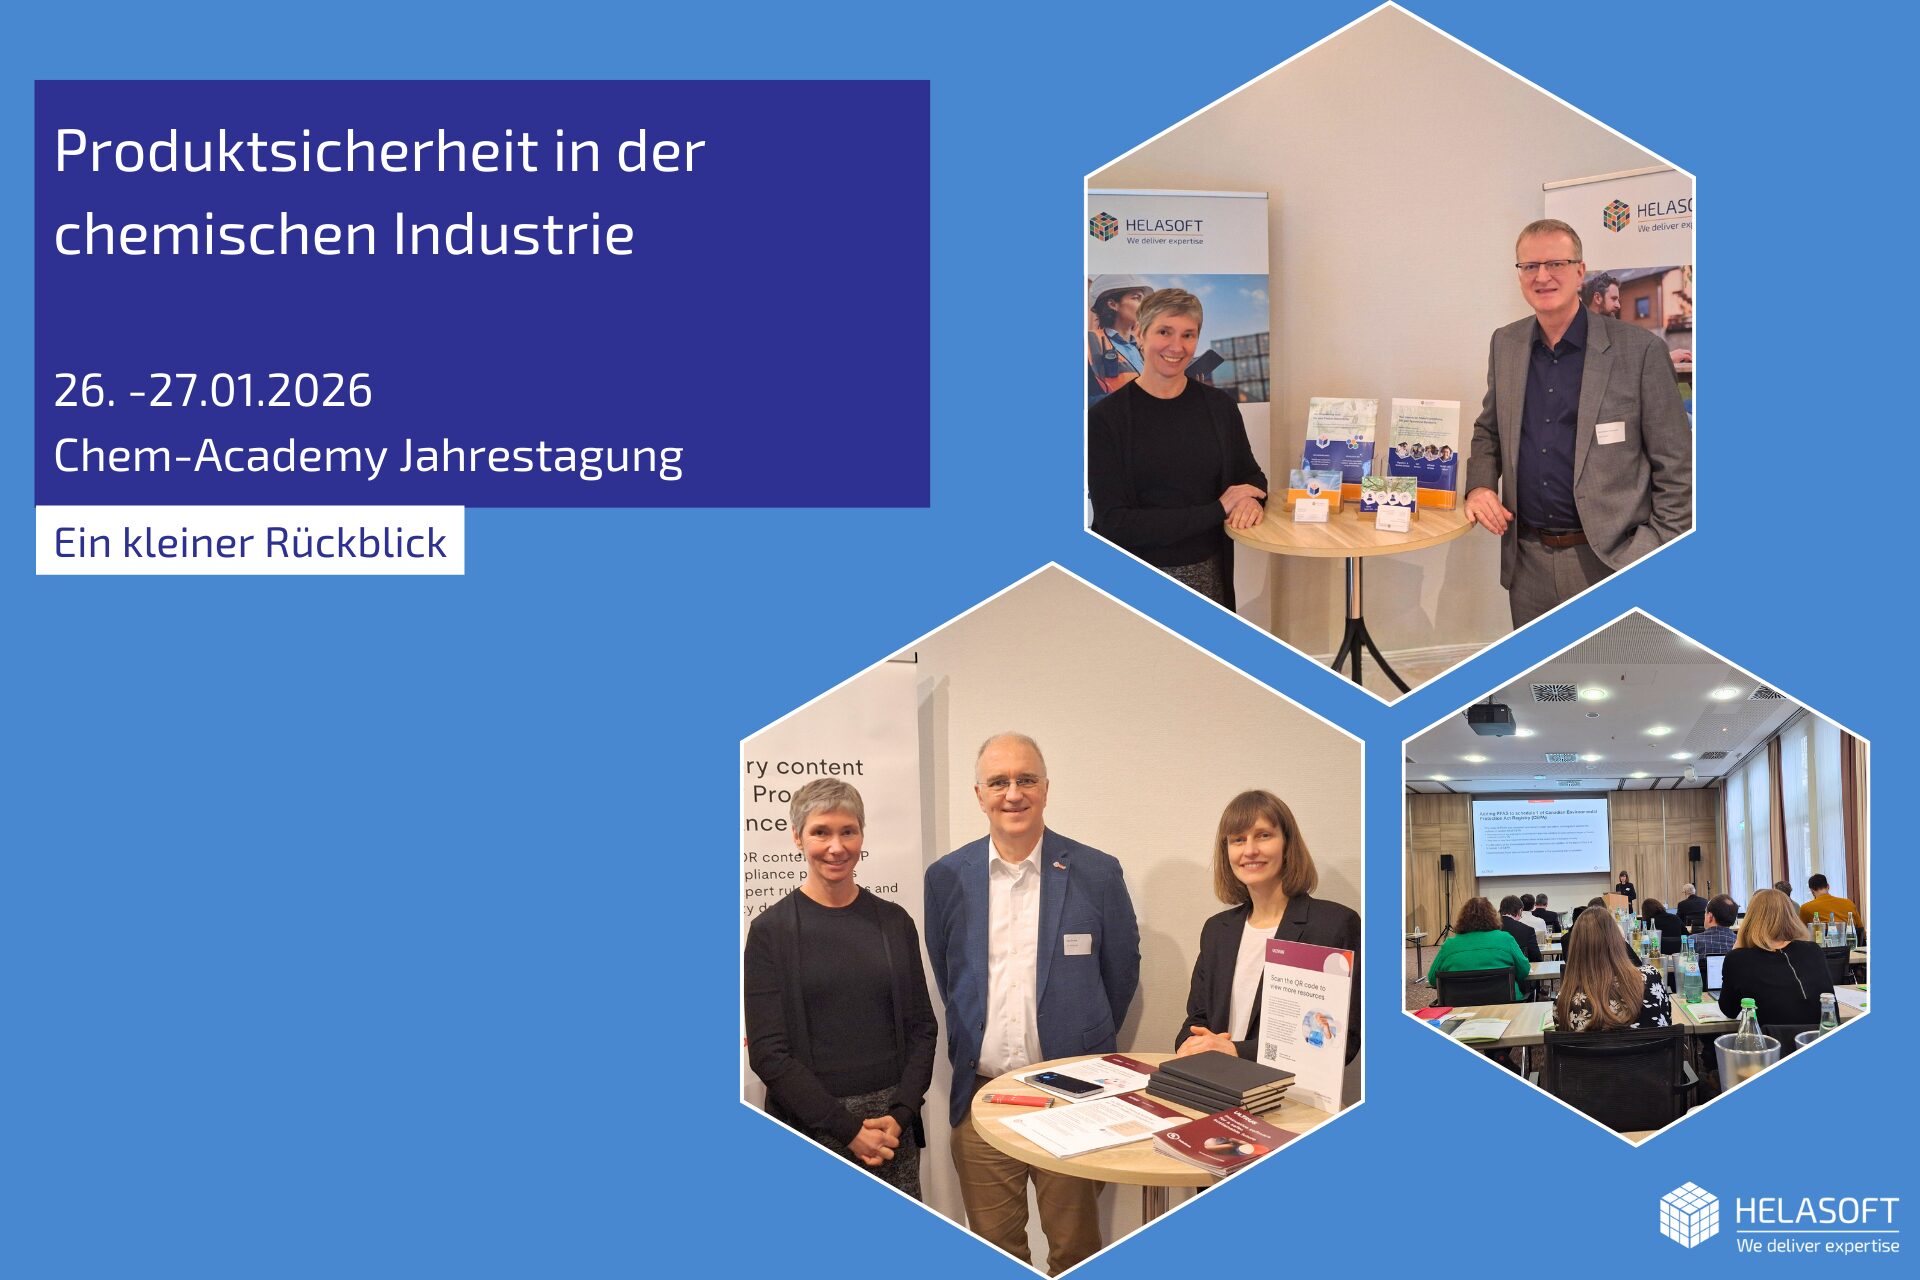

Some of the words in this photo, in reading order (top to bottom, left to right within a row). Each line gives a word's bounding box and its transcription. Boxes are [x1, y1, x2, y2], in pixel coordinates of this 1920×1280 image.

[1126, 219, 1203, 232] HELASOFT
[1638, 225, 1650, 233] We
[1652, 223, 1679, 232] deliver
[1168, 238, 1204, 246] expertise
[776, 759, 864, 776] content
[753, 785, 791, 803] Pro
[745, 818, 787, 832] nce
[745, 869, 795, 882] pliance
[745, 886, 775, 899] pert
[875, 883, 898, 893] and
[1271, 974, 1283, 984] Scan
[1284, 977, 1293, 985] the
[1294, 979, 1303, 987] QR
[1304, 982, 1319, 991] code
[1282, 987, 1297, 995] more
[1297, 989, 1325, 1001] resources
